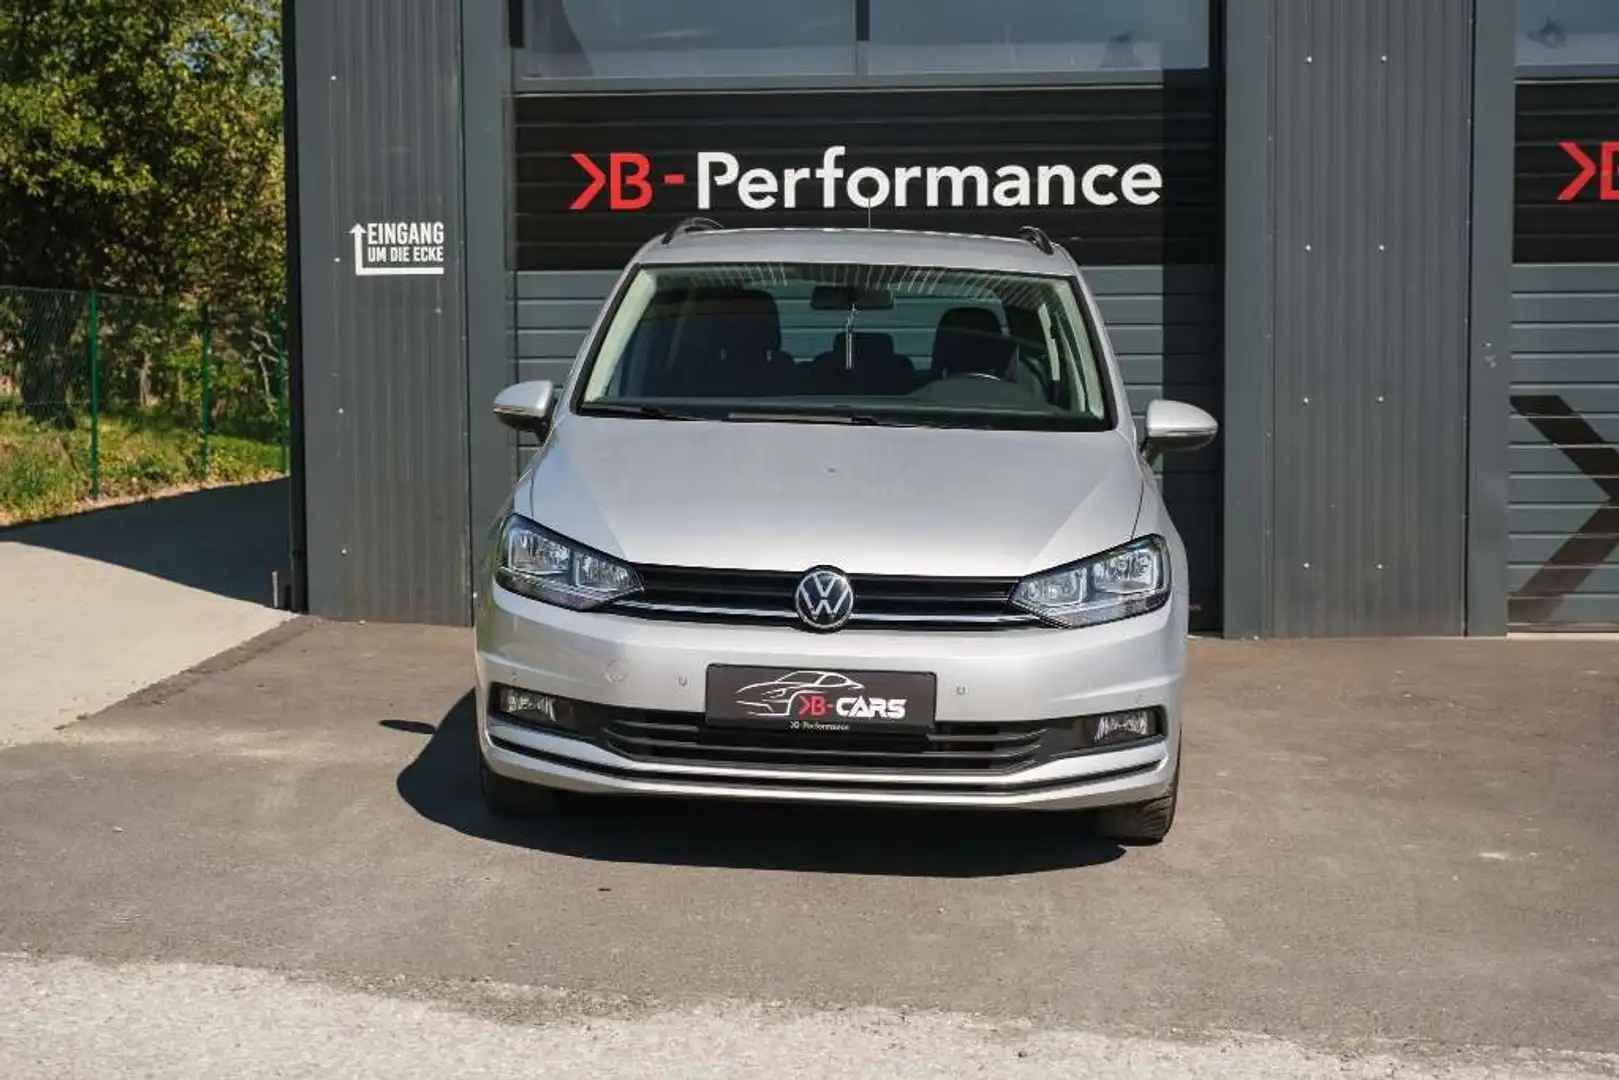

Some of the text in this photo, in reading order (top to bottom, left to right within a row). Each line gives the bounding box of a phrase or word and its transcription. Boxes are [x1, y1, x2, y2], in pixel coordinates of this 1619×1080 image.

[367, 222, 444, 245] EINGANG
[368, 246, 444, 262] UM DIE ECKE
[799, 572, 850, 622] VW
